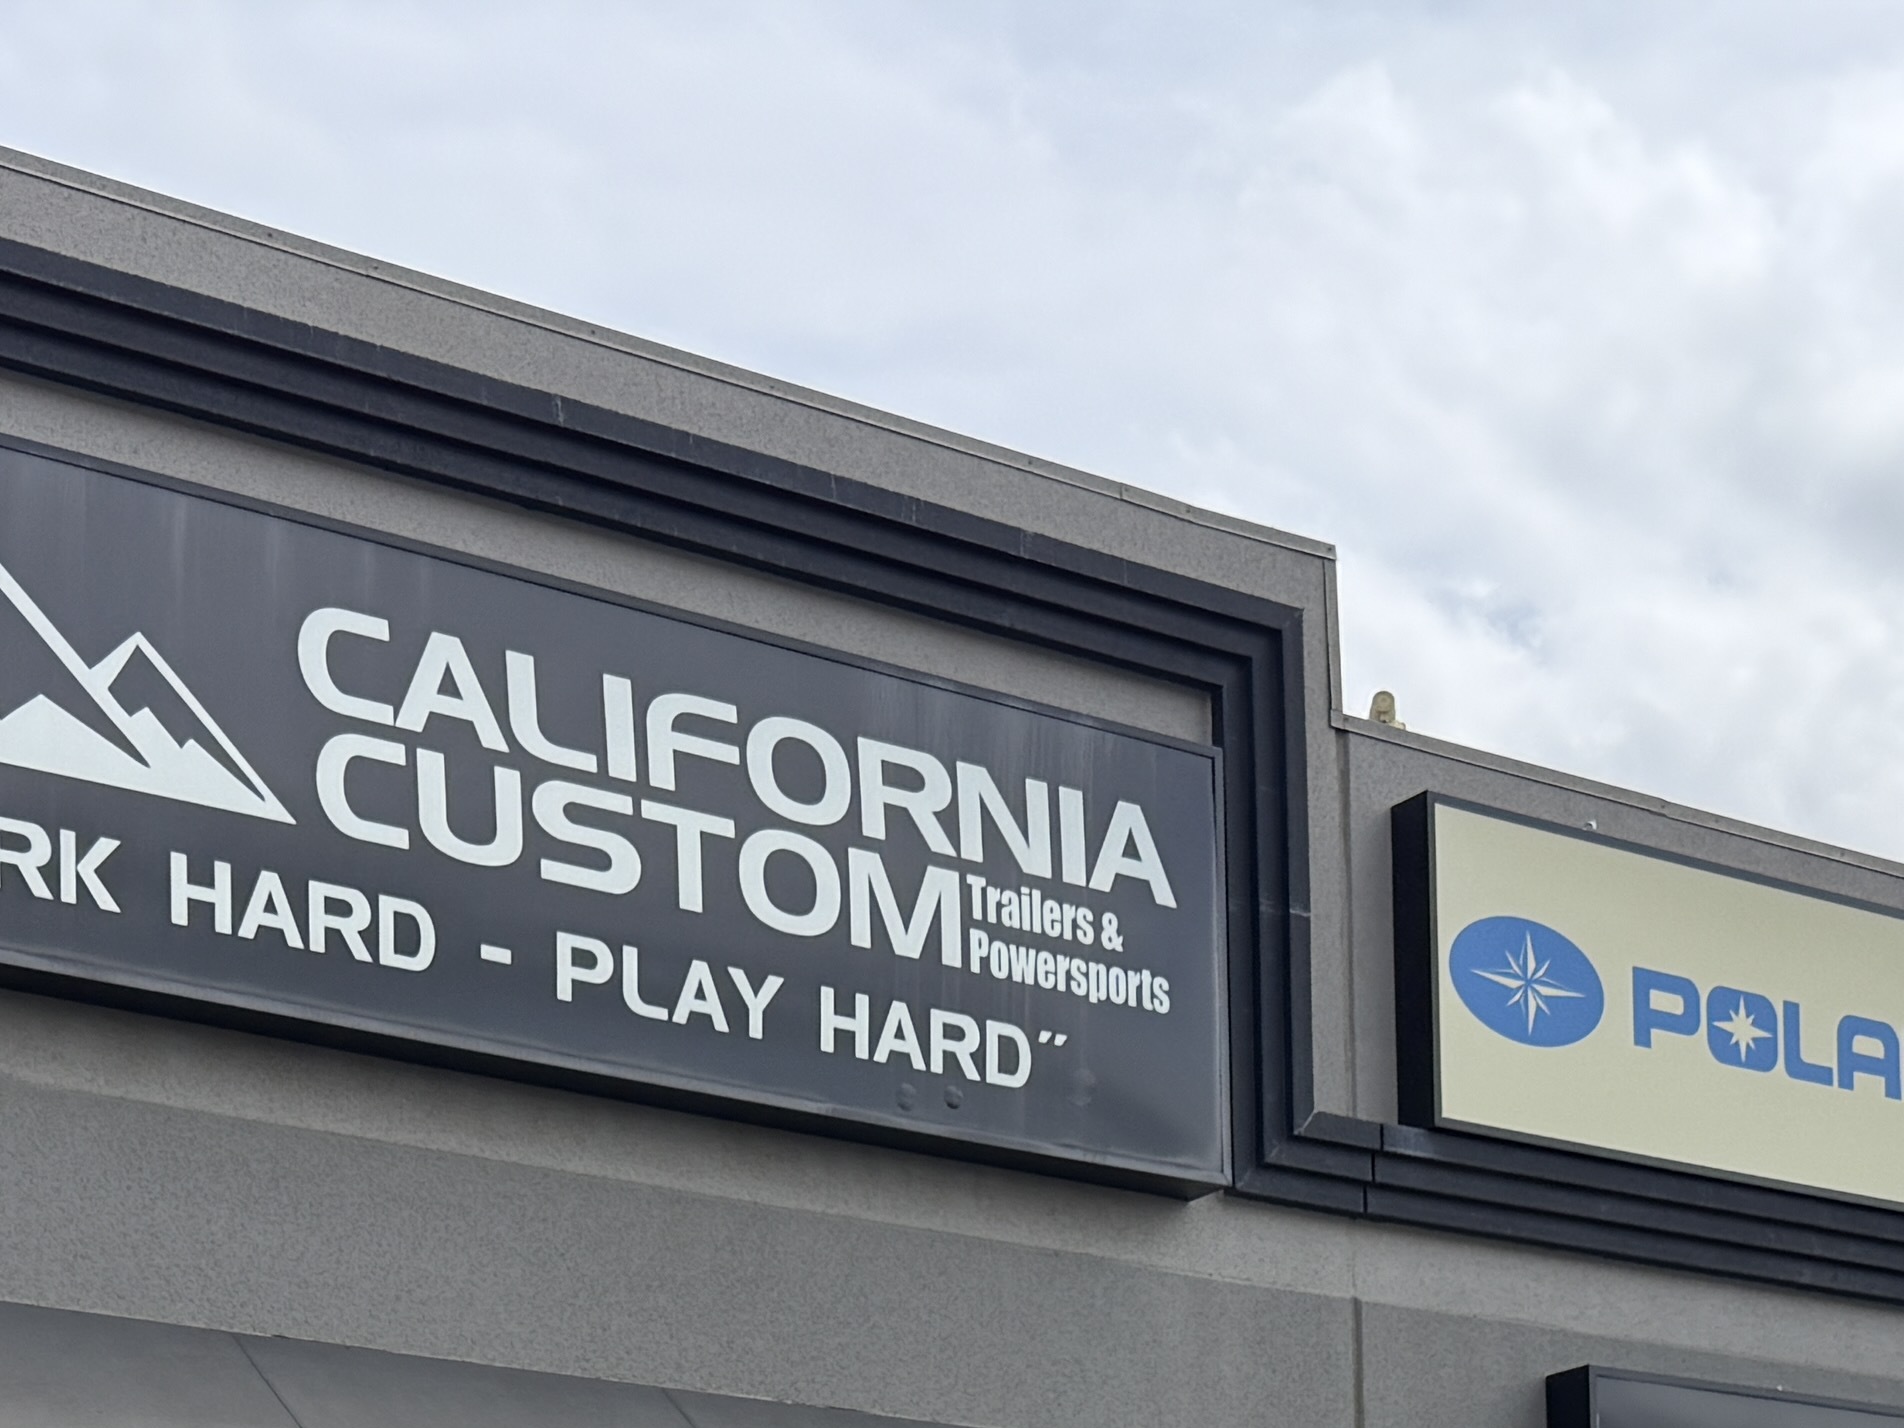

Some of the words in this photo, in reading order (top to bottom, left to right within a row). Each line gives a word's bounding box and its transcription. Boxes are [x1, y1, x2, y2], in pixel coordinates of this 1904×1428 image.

[297, 607, 1177, 909] CALIFORNIA
[315, 732, 963, 968] CUSTOM
[169, 850, 436, 973] HARD
[556, 930, 786, 1040] PLAY
[966, 873, 1095, 945] Trailers
[1099, 911, 1124, 953] &
[968, 926, 1171, 1014] Powersports
